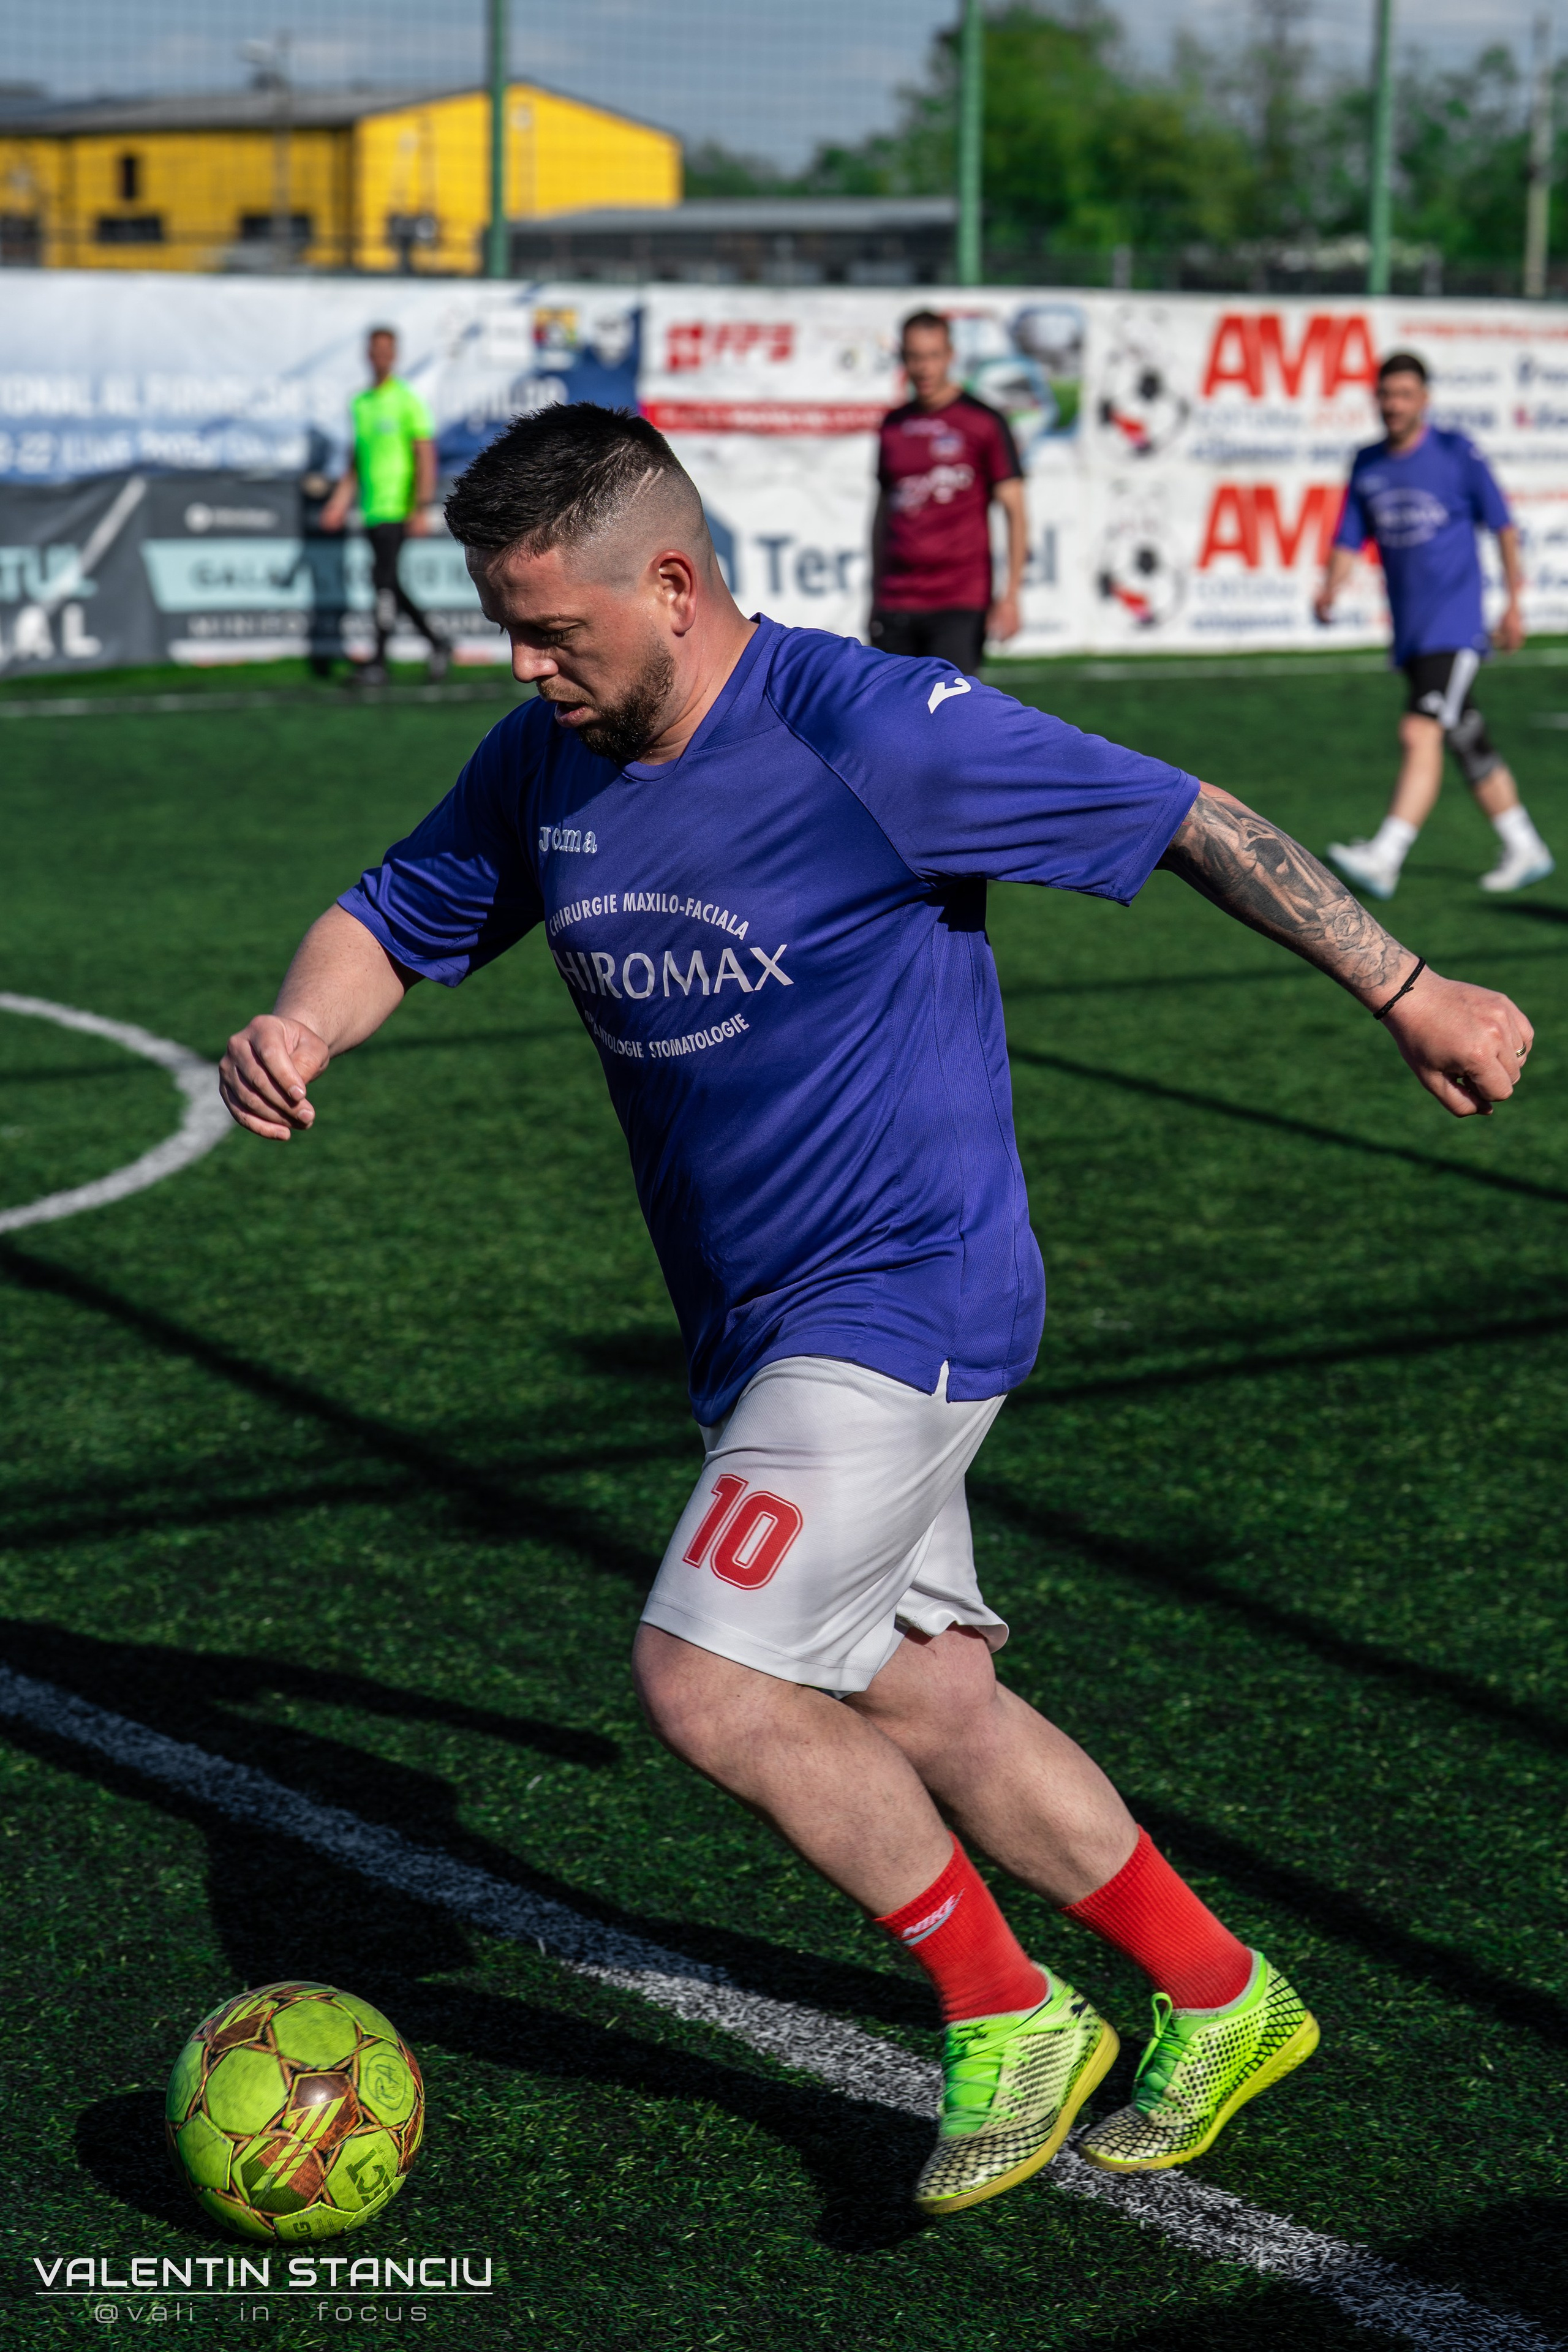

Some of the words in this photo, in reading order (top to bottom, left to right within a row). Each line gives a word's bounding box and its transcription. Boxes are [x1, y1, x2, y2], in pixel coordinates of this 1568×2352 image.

[1196, 484, 1378, 570] AM
[539, 826, 598, 854] Joma
[549, 894, 617, 937] CHIRURGIE
[623, 892, 749, 941] MAXILO-FACIALA
[649, 1013, 750, 1058] STOMATOLOGIE
[682, 1473, 803, 1591] 10
